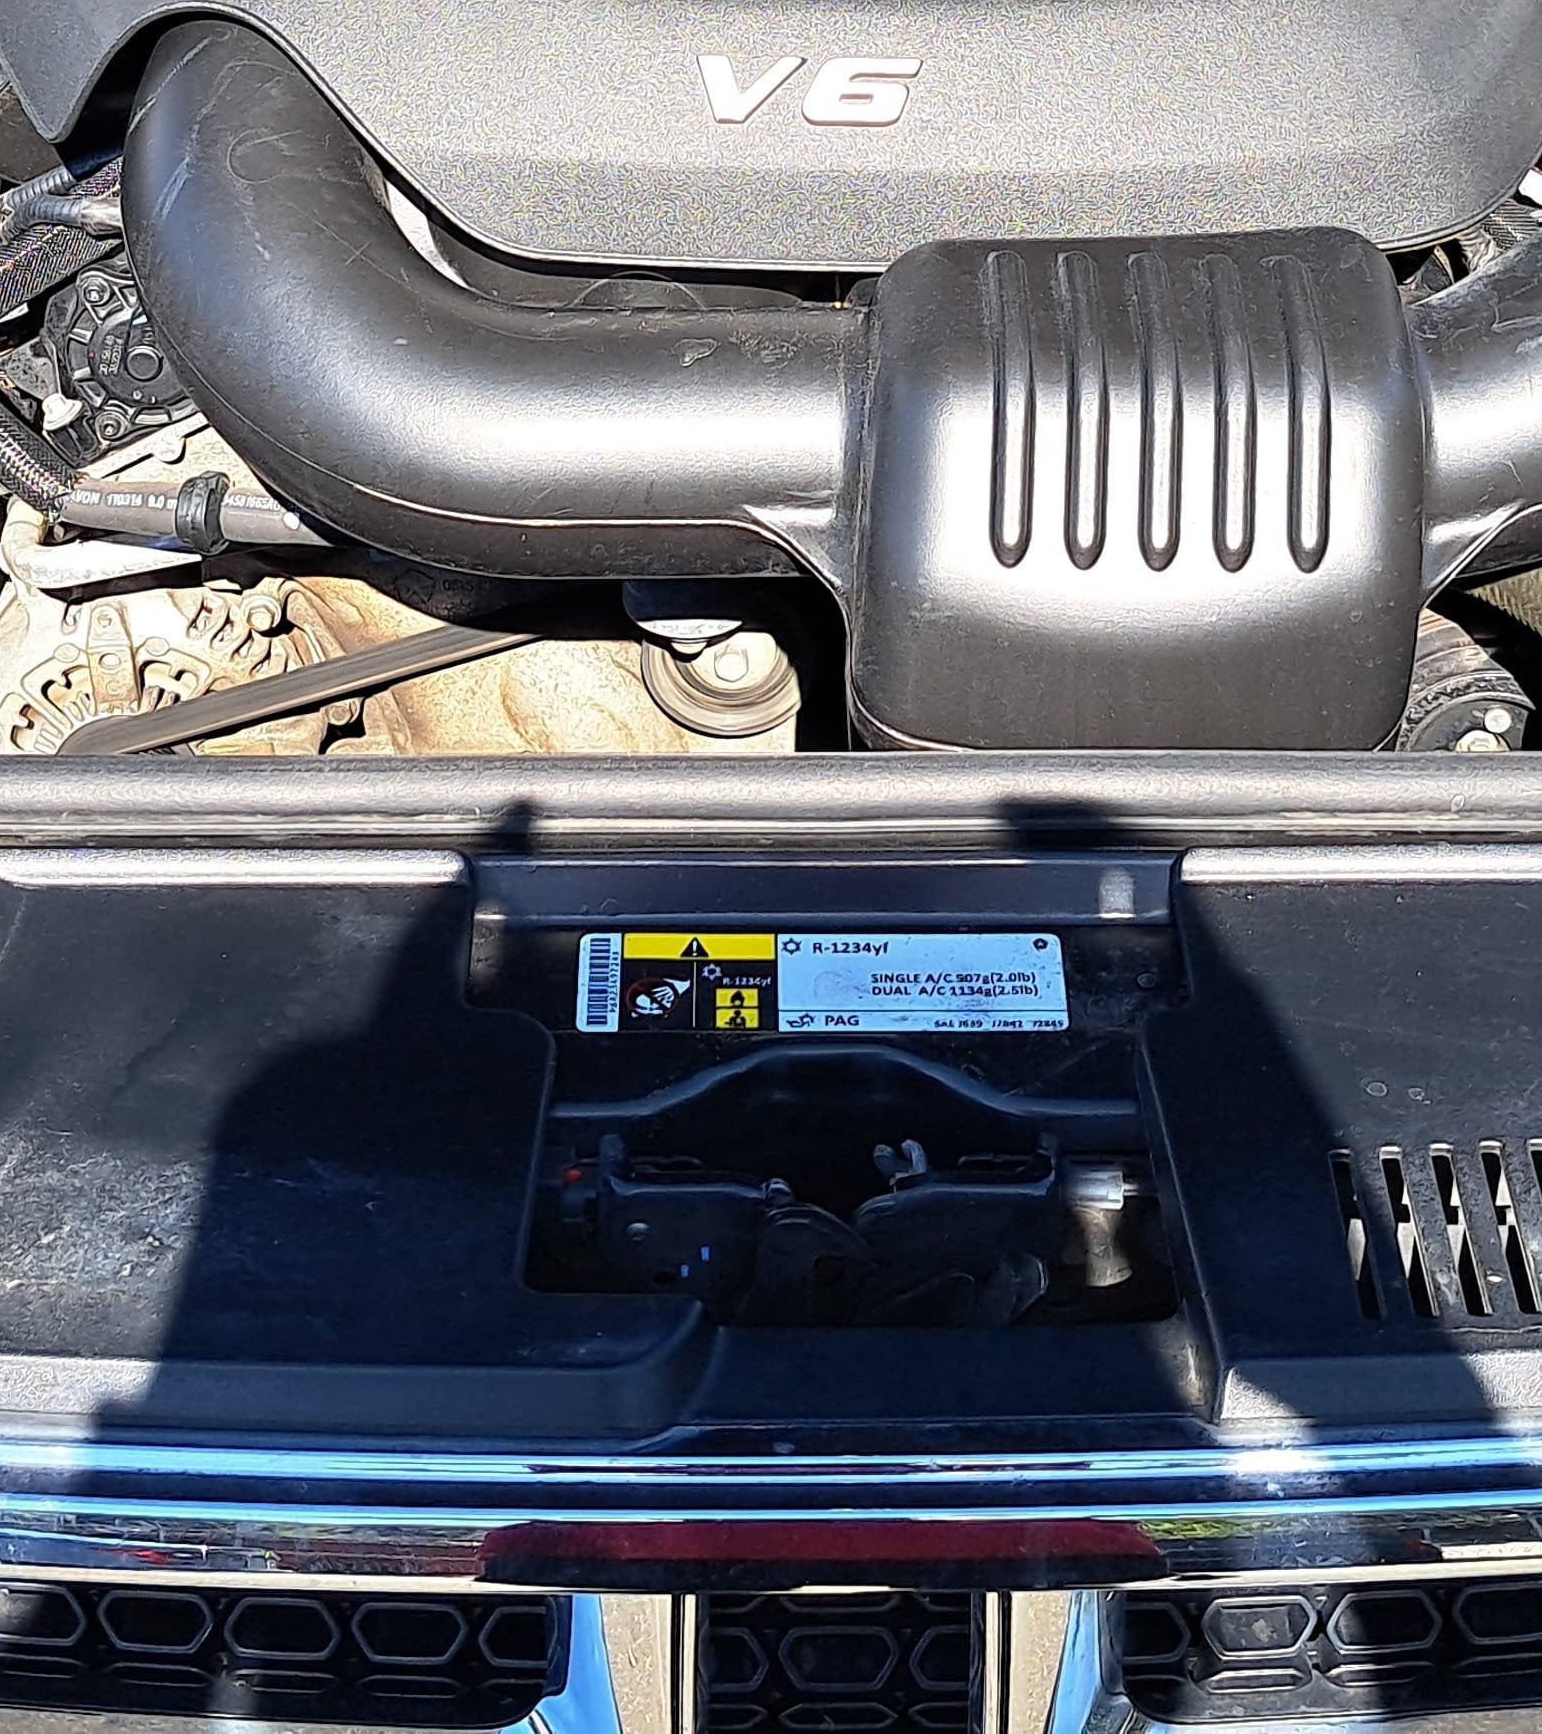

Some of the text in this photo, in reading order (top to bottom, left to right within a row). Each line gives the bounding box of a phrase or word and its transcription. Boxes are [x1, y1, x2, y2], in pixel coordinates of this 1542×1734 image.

[696, 54, 925, 128] V6
[812, 941, 889, 957] R-1234yf
[870, 973, 921, 984] SINGLE
[925, 972, 953, 984] A/C
[871, 986, 911, 996] DUAL
[918, 985, 947, 997] A/C
[824, 1014, 860, 1027] PAG
